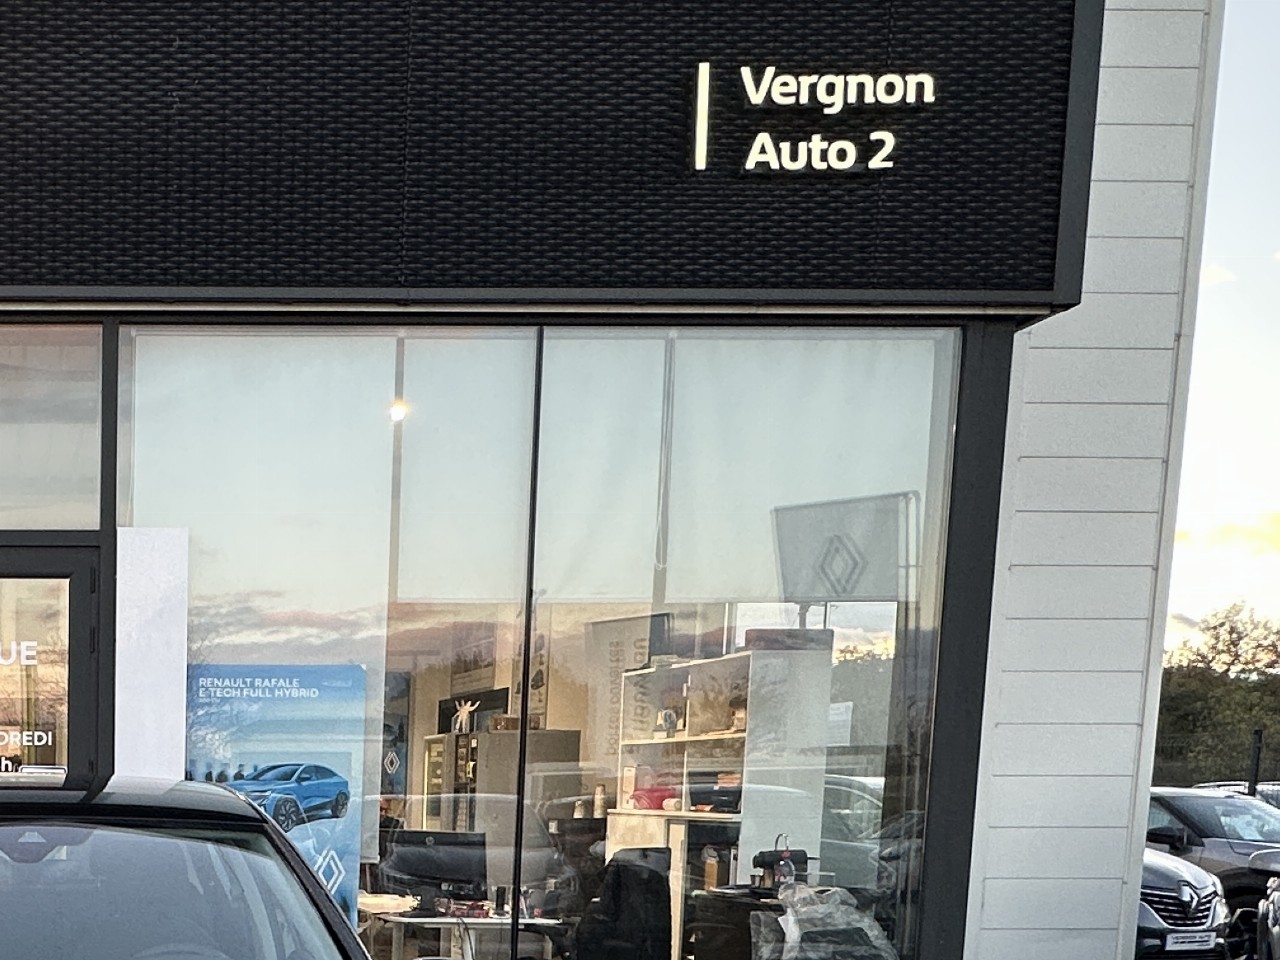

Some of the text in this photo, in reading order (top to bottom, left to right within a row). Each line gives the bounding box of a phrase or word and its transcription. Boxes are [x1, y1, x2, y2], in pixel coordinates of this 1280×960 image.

[741, 66, 935, 114] Vergnon
[745, 131, 895, 170] Auto 2
[199, 677, 300, 688] RENAULT RAFALE
[244, 688, 271, 698] FULL
[275, 688, 319, 698] HYBRID
